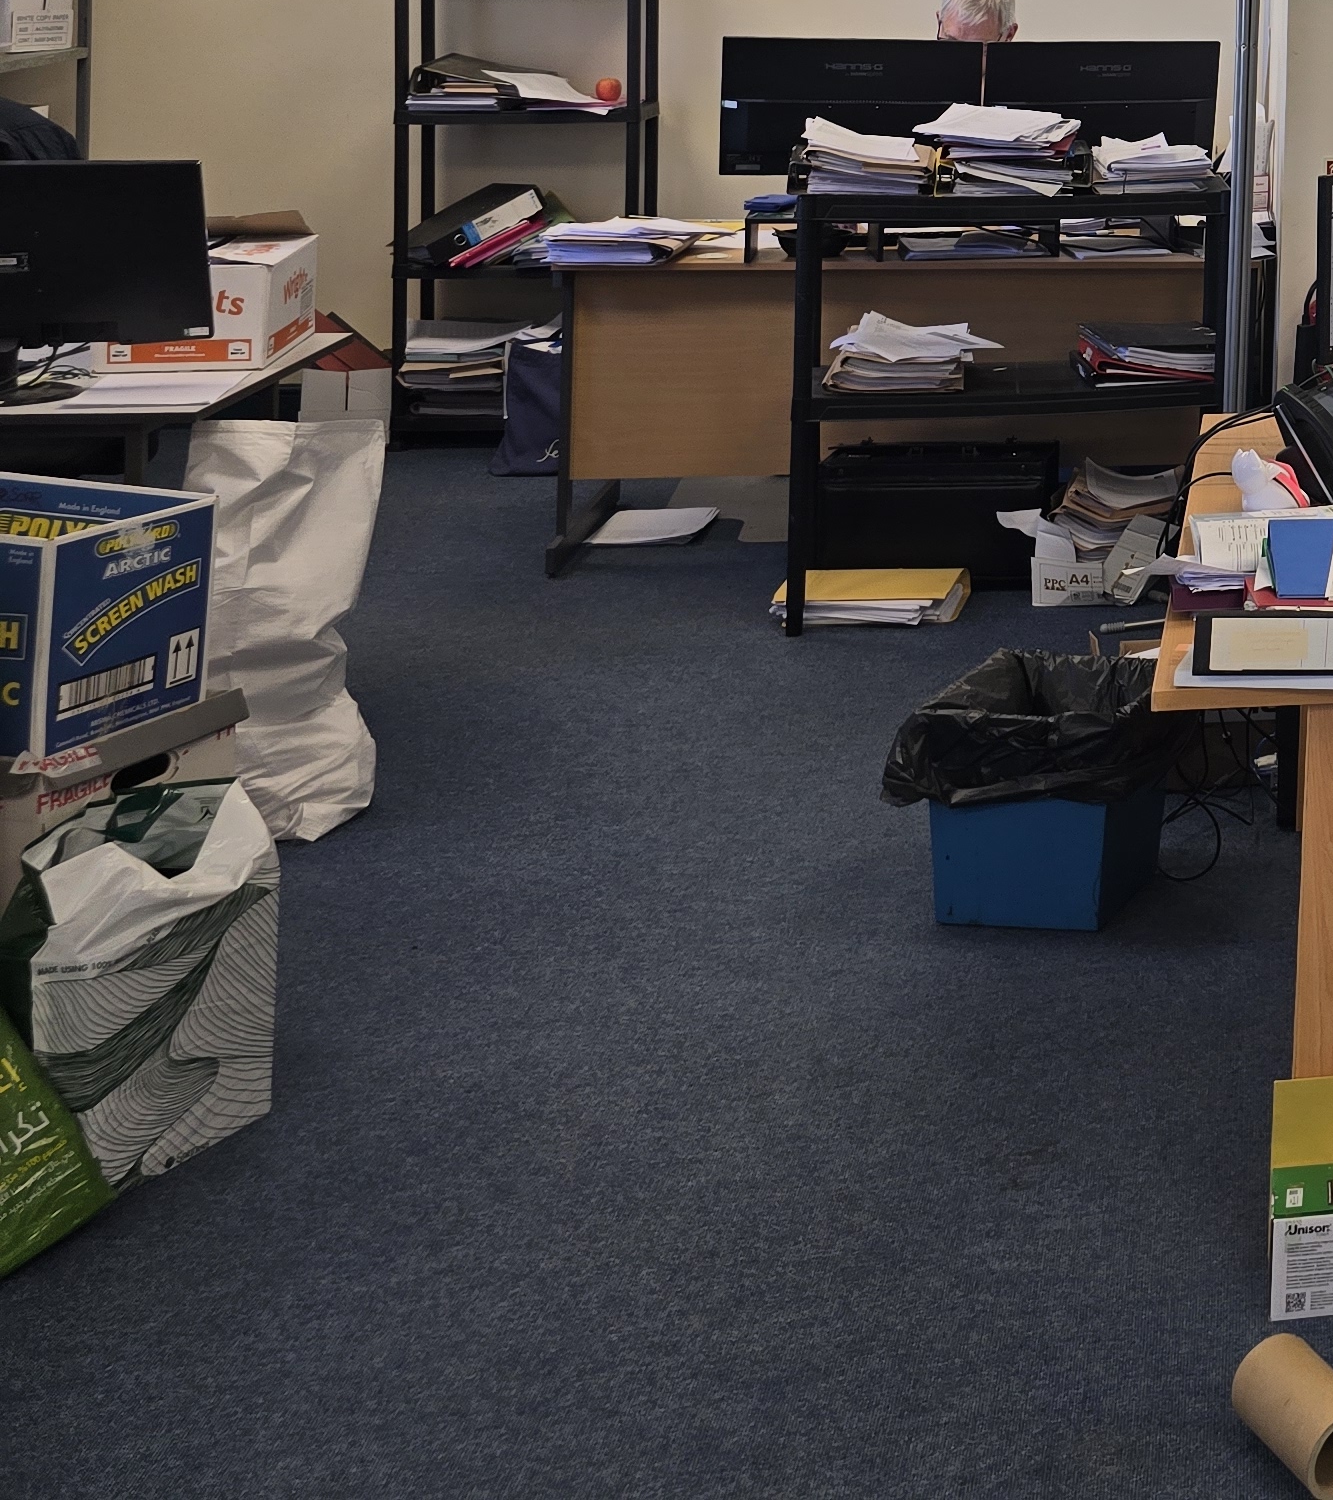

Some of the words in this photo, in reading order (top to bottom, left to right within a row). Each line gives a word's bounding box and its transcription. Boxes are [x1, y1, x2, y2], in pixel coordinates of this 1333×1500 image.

[58, 502, 81, 511] Made
[91, 504, 122, 516] England
[102, 546, 172, 580] ARCTIC
[1069, 573, 1090, 585] A4
[73, 590, 144, 656] SCREEN
[145, 563, 198, 602] WASH
[37, 965, 59, 976] MADE
[60, 963, 89, 974] USING
